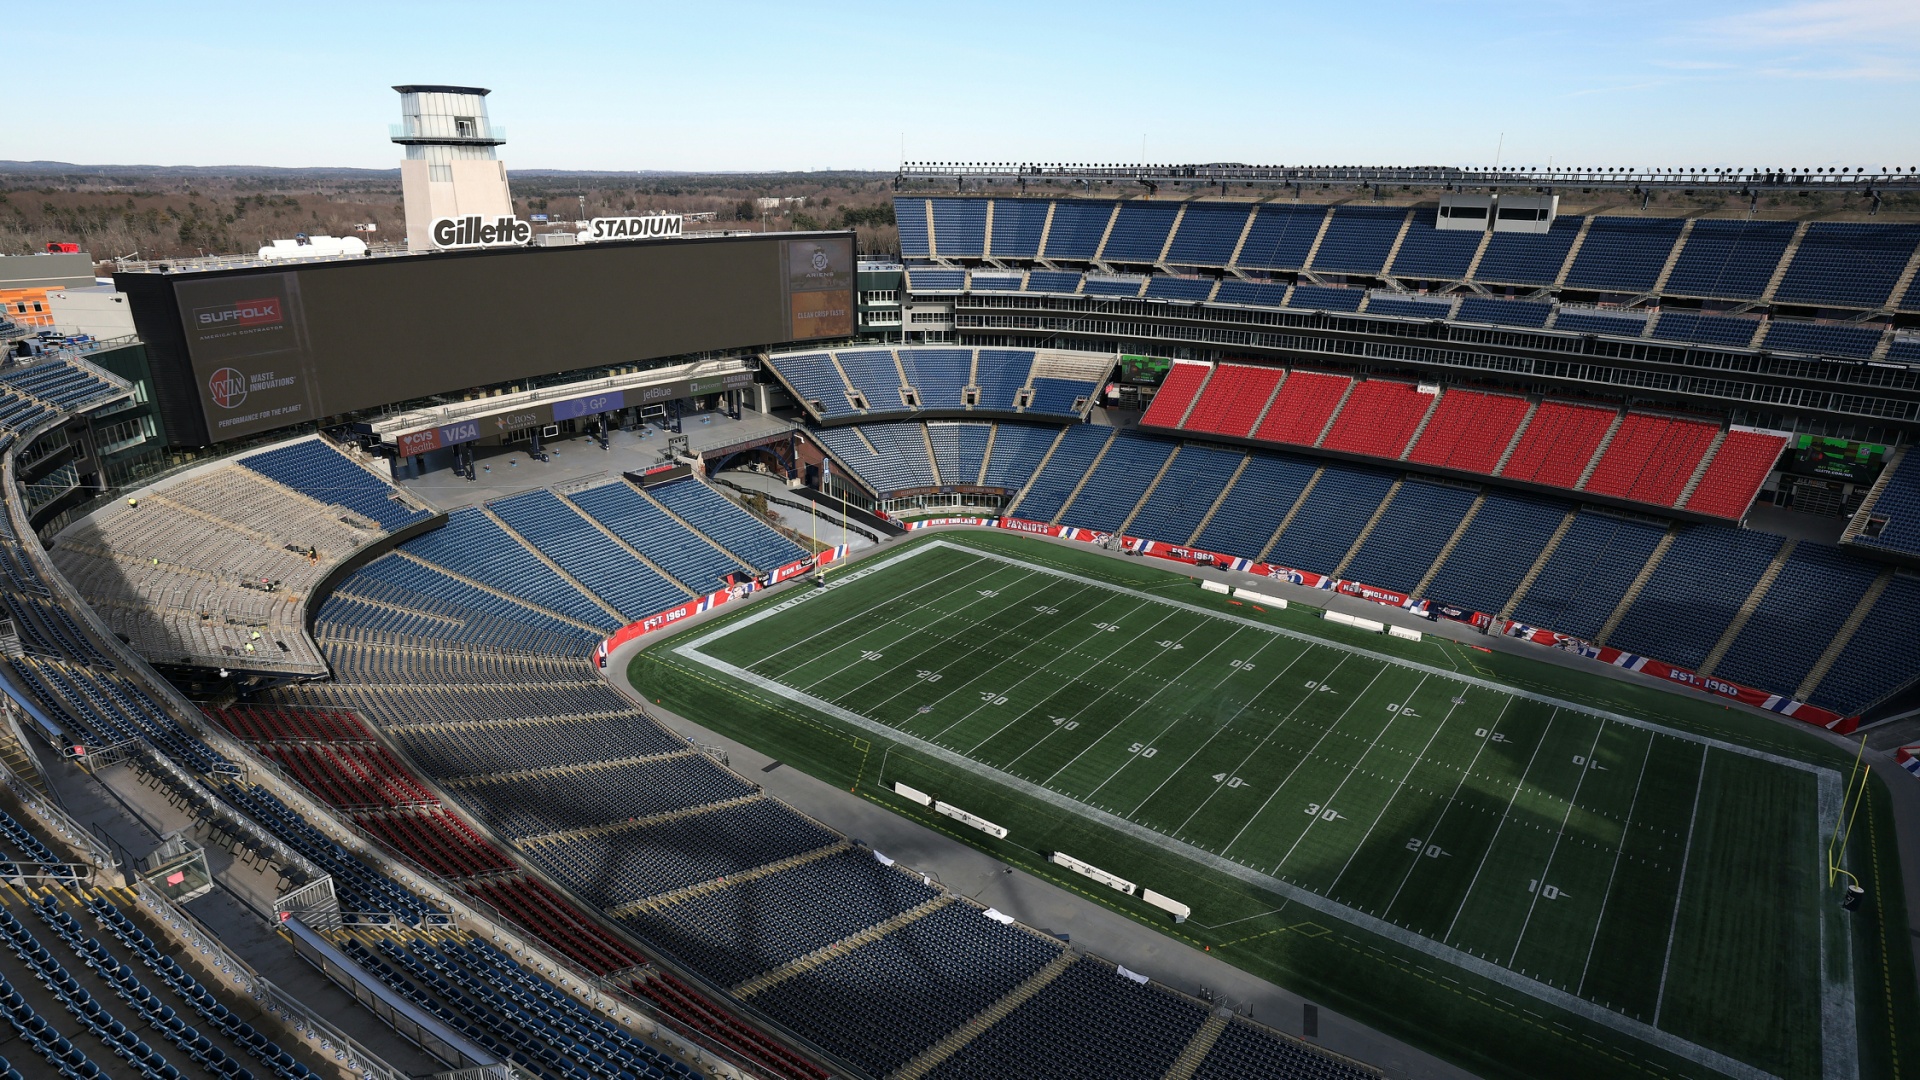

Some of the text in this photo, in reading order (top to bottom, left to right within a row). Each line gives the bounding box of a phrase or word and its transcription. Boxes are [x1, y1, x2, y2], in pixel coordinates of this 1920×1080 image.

[434, 216, 681, 246] Gillette STADIUM
[199, 305, 275, 324] SUFFOLK
[814, 310, 829, 318] CRISP
[199, 325, 284, 341] AMERICA'S CONTRACTOR
[249, 376, 295, 392] INNOVATIONS
[250, 372, 275, 383] WASTE
[698, 382, 721, 391] paycom
[642, 387, 672, 401] jetBlue
[218, 404, 302, 428] PERFORMANCE FOR THE PLANET
[412, 431, 433, 443] CVS
[443, 424, 477, 442] VISA
[931, 517, 978, 525] NEW ENGLAND
[1006, 519, 1048, 534] PATRIOTS
[1193, 551, 1215, 563] 1960
[824, 579, 844, 590] ALL
[665, 607, 687, 622] 1960
[1036, 605, 1059, 615] 20
[1095, 622, 1120, 632] 30
[1160, 640, 1184, 650] 40
[1229, 659, 1256, 672] 50
[916, 670, 943, 682] 20
[1669, 669, 1738, 696] EST. 1960
[1304, 680, 1331, 692] 40
[981, 692, 1009, 705] 30
[1386, 703, 1415, 716] 30
[1052, 717, 1080, 730] 40
[1474, 728, 1505, 742] 20
[1127, 742, 1158, 758] 50
[1212, 773, 1243, 788] 40
[1304, 803, 1338, 822] 30
[1405, 838, 1442, 859] 20
[1528, 879, 1559, 900] 10
